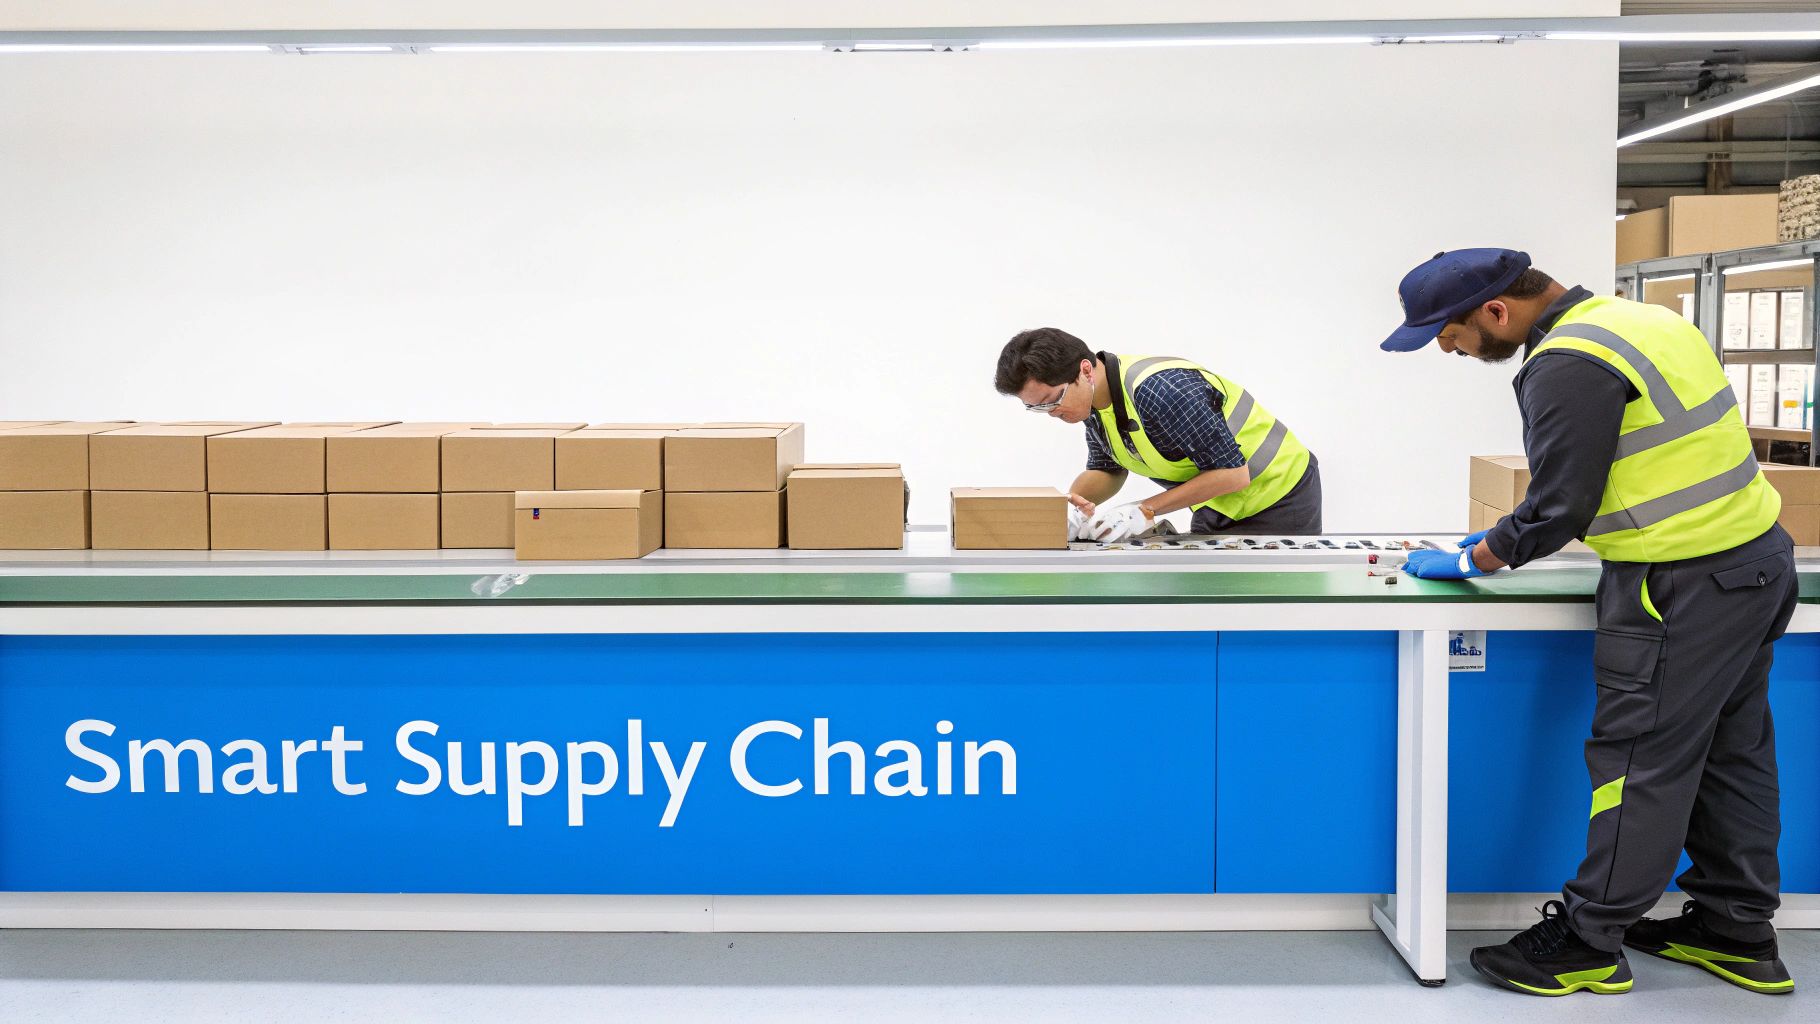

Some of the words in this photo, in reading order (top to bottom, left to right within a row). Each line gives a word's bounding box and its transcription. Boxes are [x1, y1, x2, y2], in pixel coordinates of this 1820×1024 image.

[65, 719, 368, 796] Smart
[395, 719, 707, 828] Supply
[729, 717, 1018, 797] Chain
